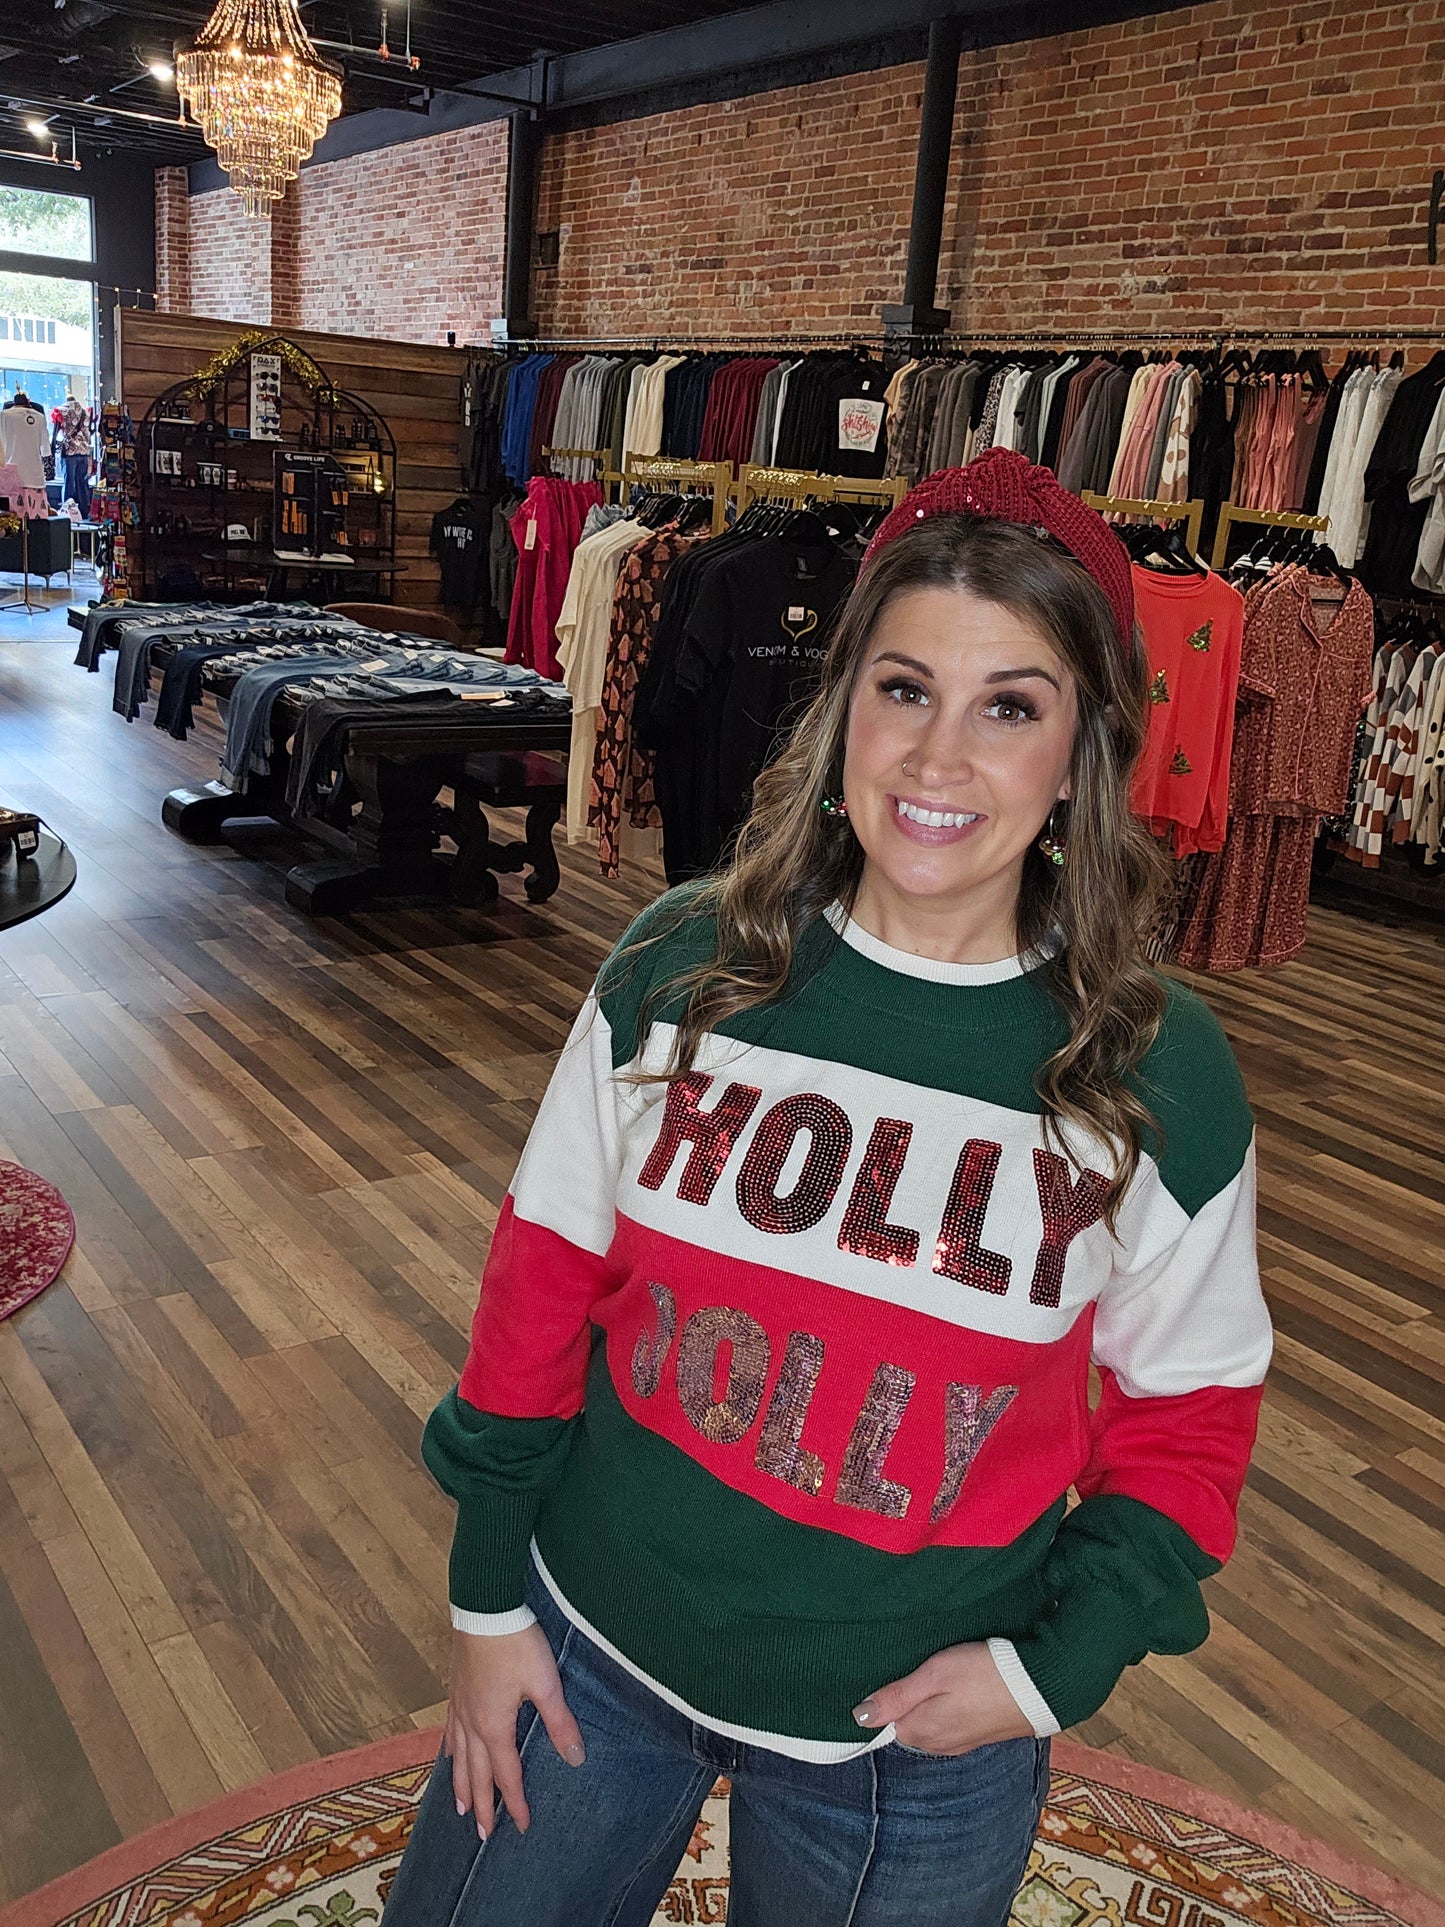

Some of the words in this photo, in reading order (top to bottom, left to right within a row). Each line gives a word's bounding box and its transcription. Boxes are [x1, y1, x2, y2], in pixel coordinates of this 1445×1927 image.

[257, 356, 276, 365] DAX
[791, 645, 800, 657] &
[804, 647, 828, 660] VOG
[637, 1070, 1112, 1309] HOLLY
[631, 1280, 1020, 1526] JOLLY
